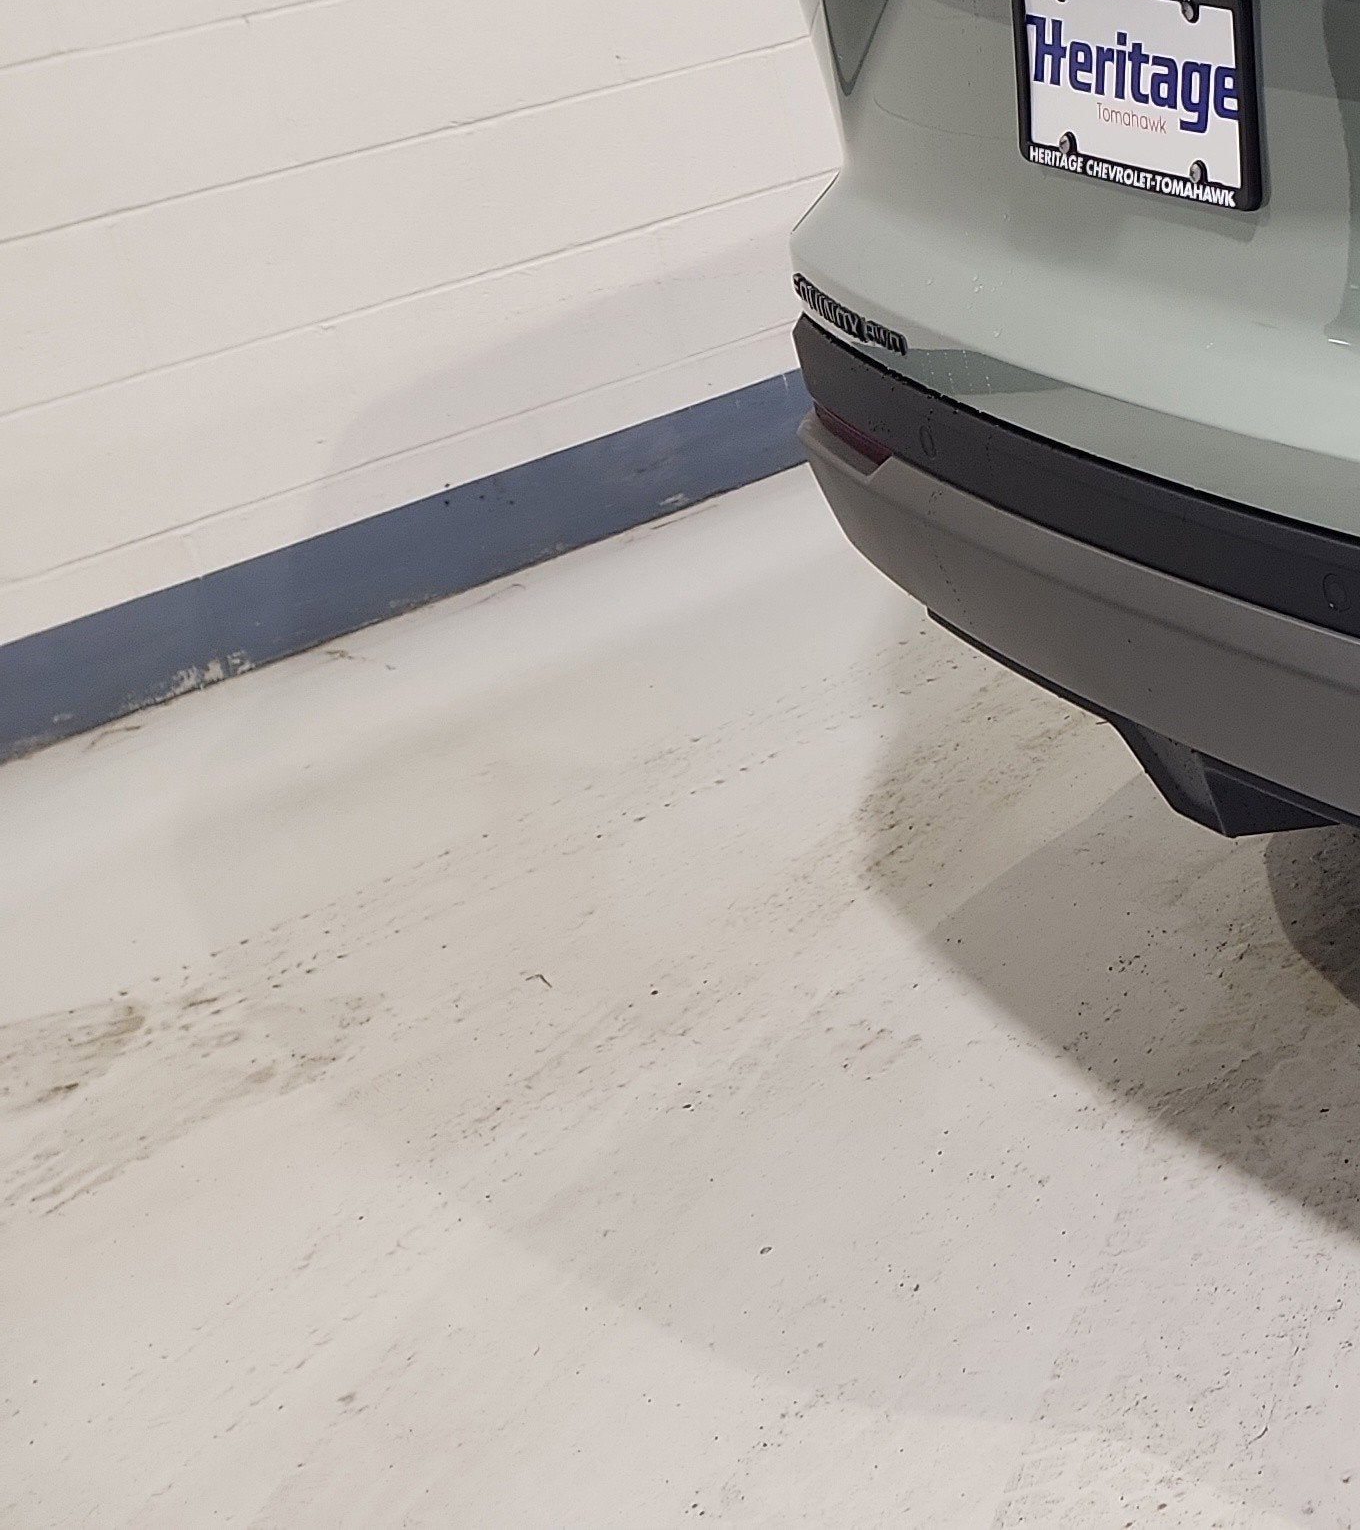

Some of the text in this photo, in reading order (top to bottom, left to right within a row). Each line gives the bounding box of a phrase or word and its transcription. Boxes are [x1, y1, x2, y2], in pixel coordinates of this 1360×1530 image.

[1026, 14, 1239, 133] Heritage
[1096, 102, 1167, 134] Tomahawk
[1029, 146, 1236, 208] HERITAGE CHEVROLET-TOMAHAWK
